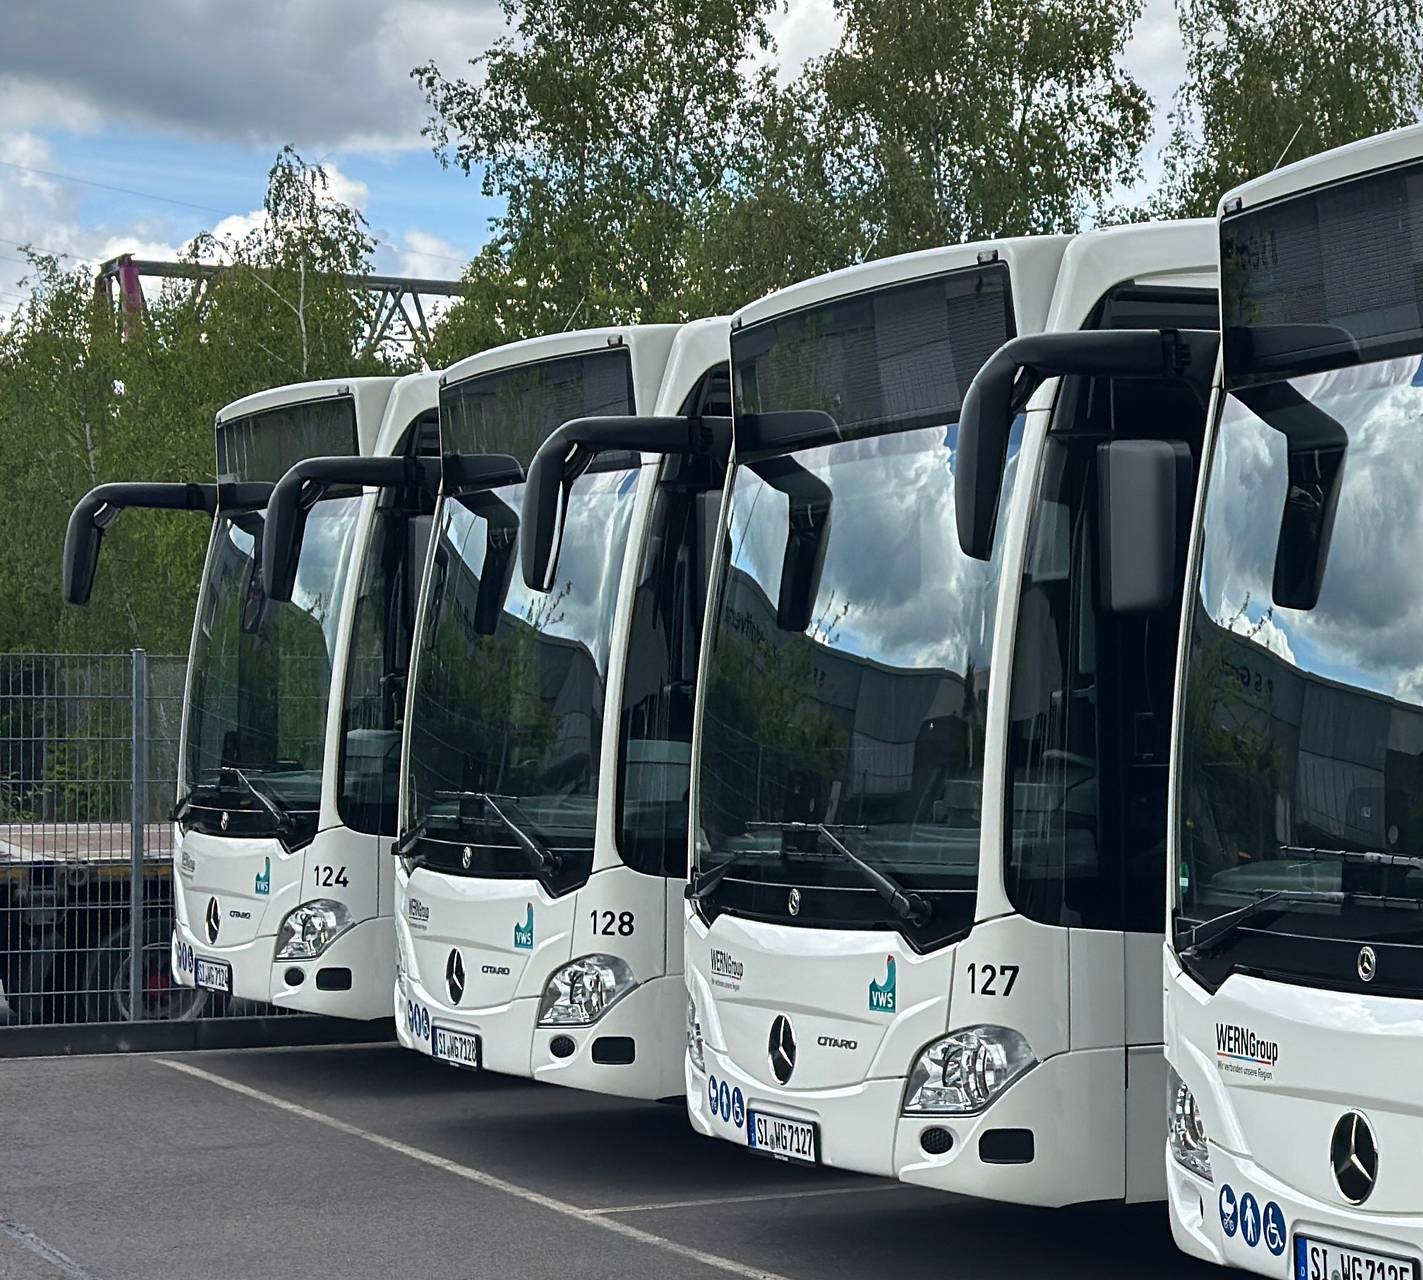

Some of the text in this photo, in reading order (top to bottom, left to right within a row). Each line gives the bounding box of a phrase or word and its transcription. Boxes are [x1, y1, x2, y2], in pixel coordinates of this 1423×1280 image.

[256, 881, 269, 892] VWS
[314, 865, 349, 887] 124
[590, 910, 635, 937] 128
[516, 931, 532, 945] VWS
[710, 948, 744, 981] WERNGroup
[967, 962, 1020, 997] 127
[872, 991, 894, 1007] VWS
[817, 1036, 858, 1050] CITARO
[1215, 1023, 1278, 1066] WERNGroup
[757, 1117, 769, 1146] SI
